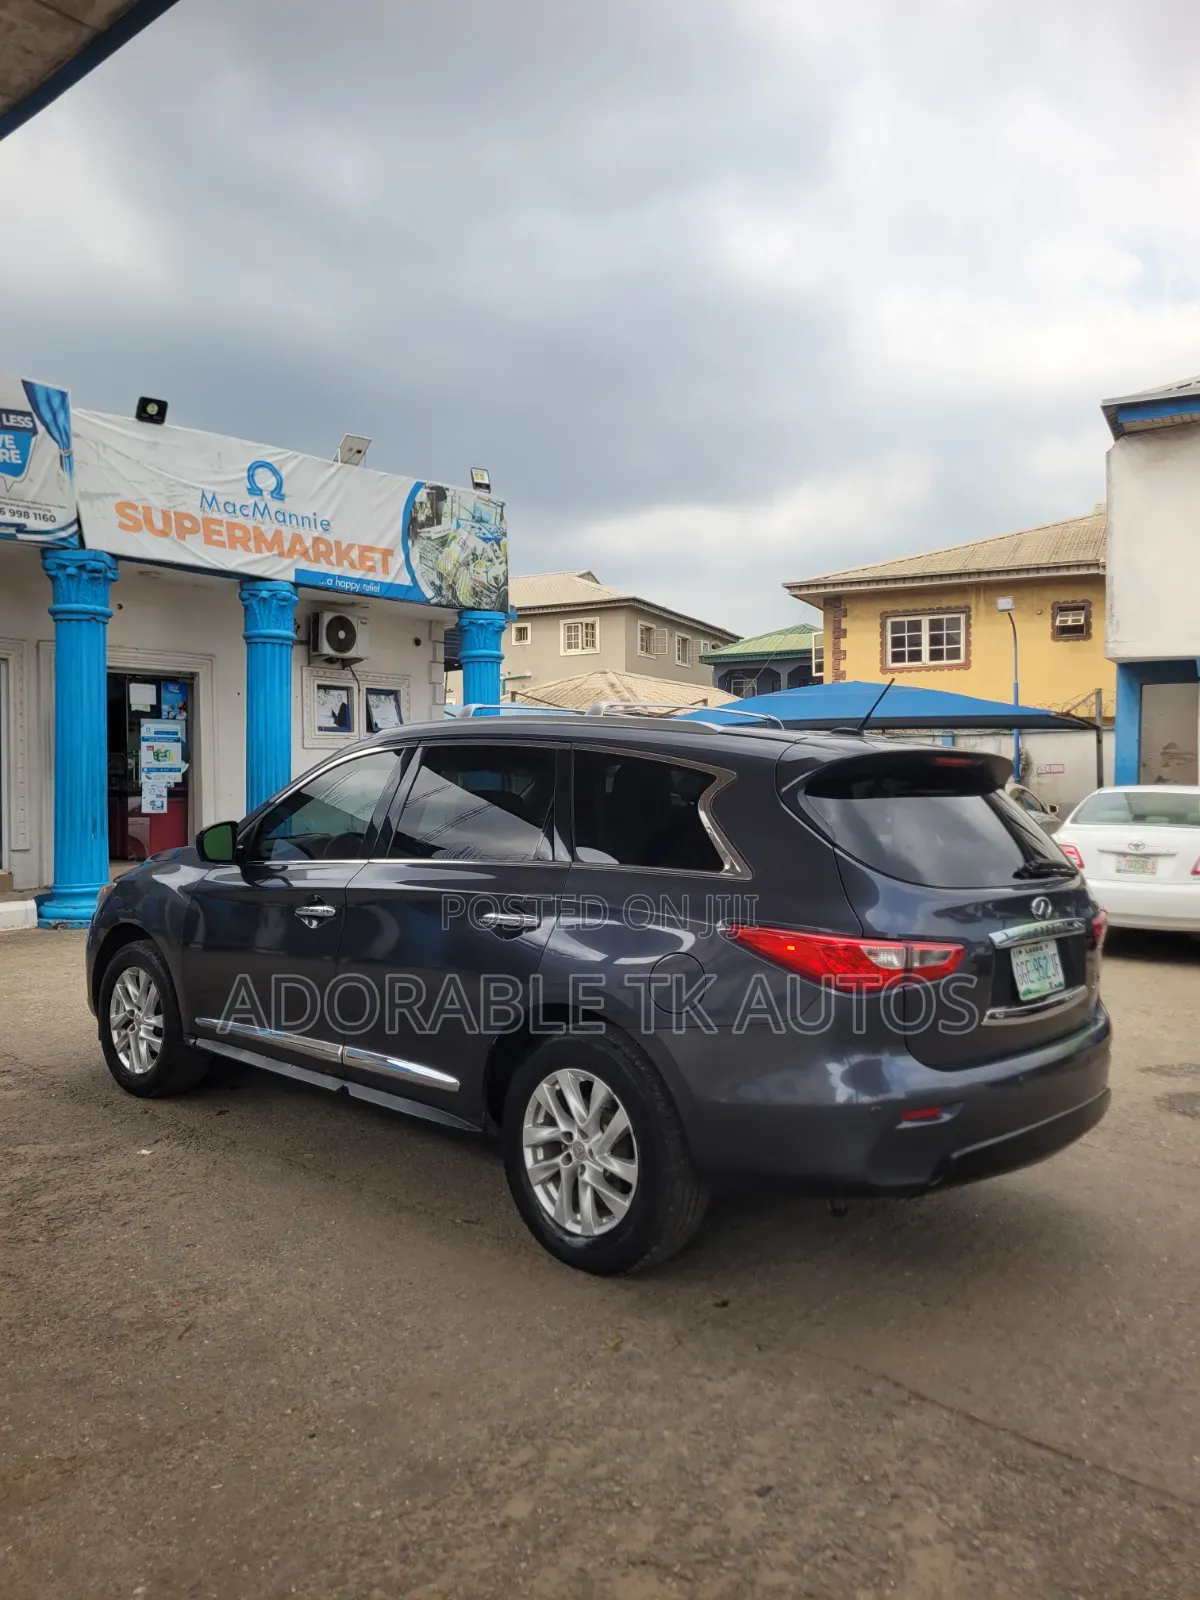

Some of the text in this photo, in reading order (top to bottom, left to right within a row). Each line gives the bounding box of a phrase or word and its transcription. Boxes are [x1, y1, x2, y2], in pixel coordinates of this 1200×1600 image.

[1, 413, 33, 428] LESS
[8, 508, 30, 520] 998
[33, 512, 56, 523] 1160
[200, 490, 331, 532] MacMannie
[115, 501, 394, 575] SUPERMARKET
[335, 576, 360, 592] happy
[363, 583, 381, 593] relief
